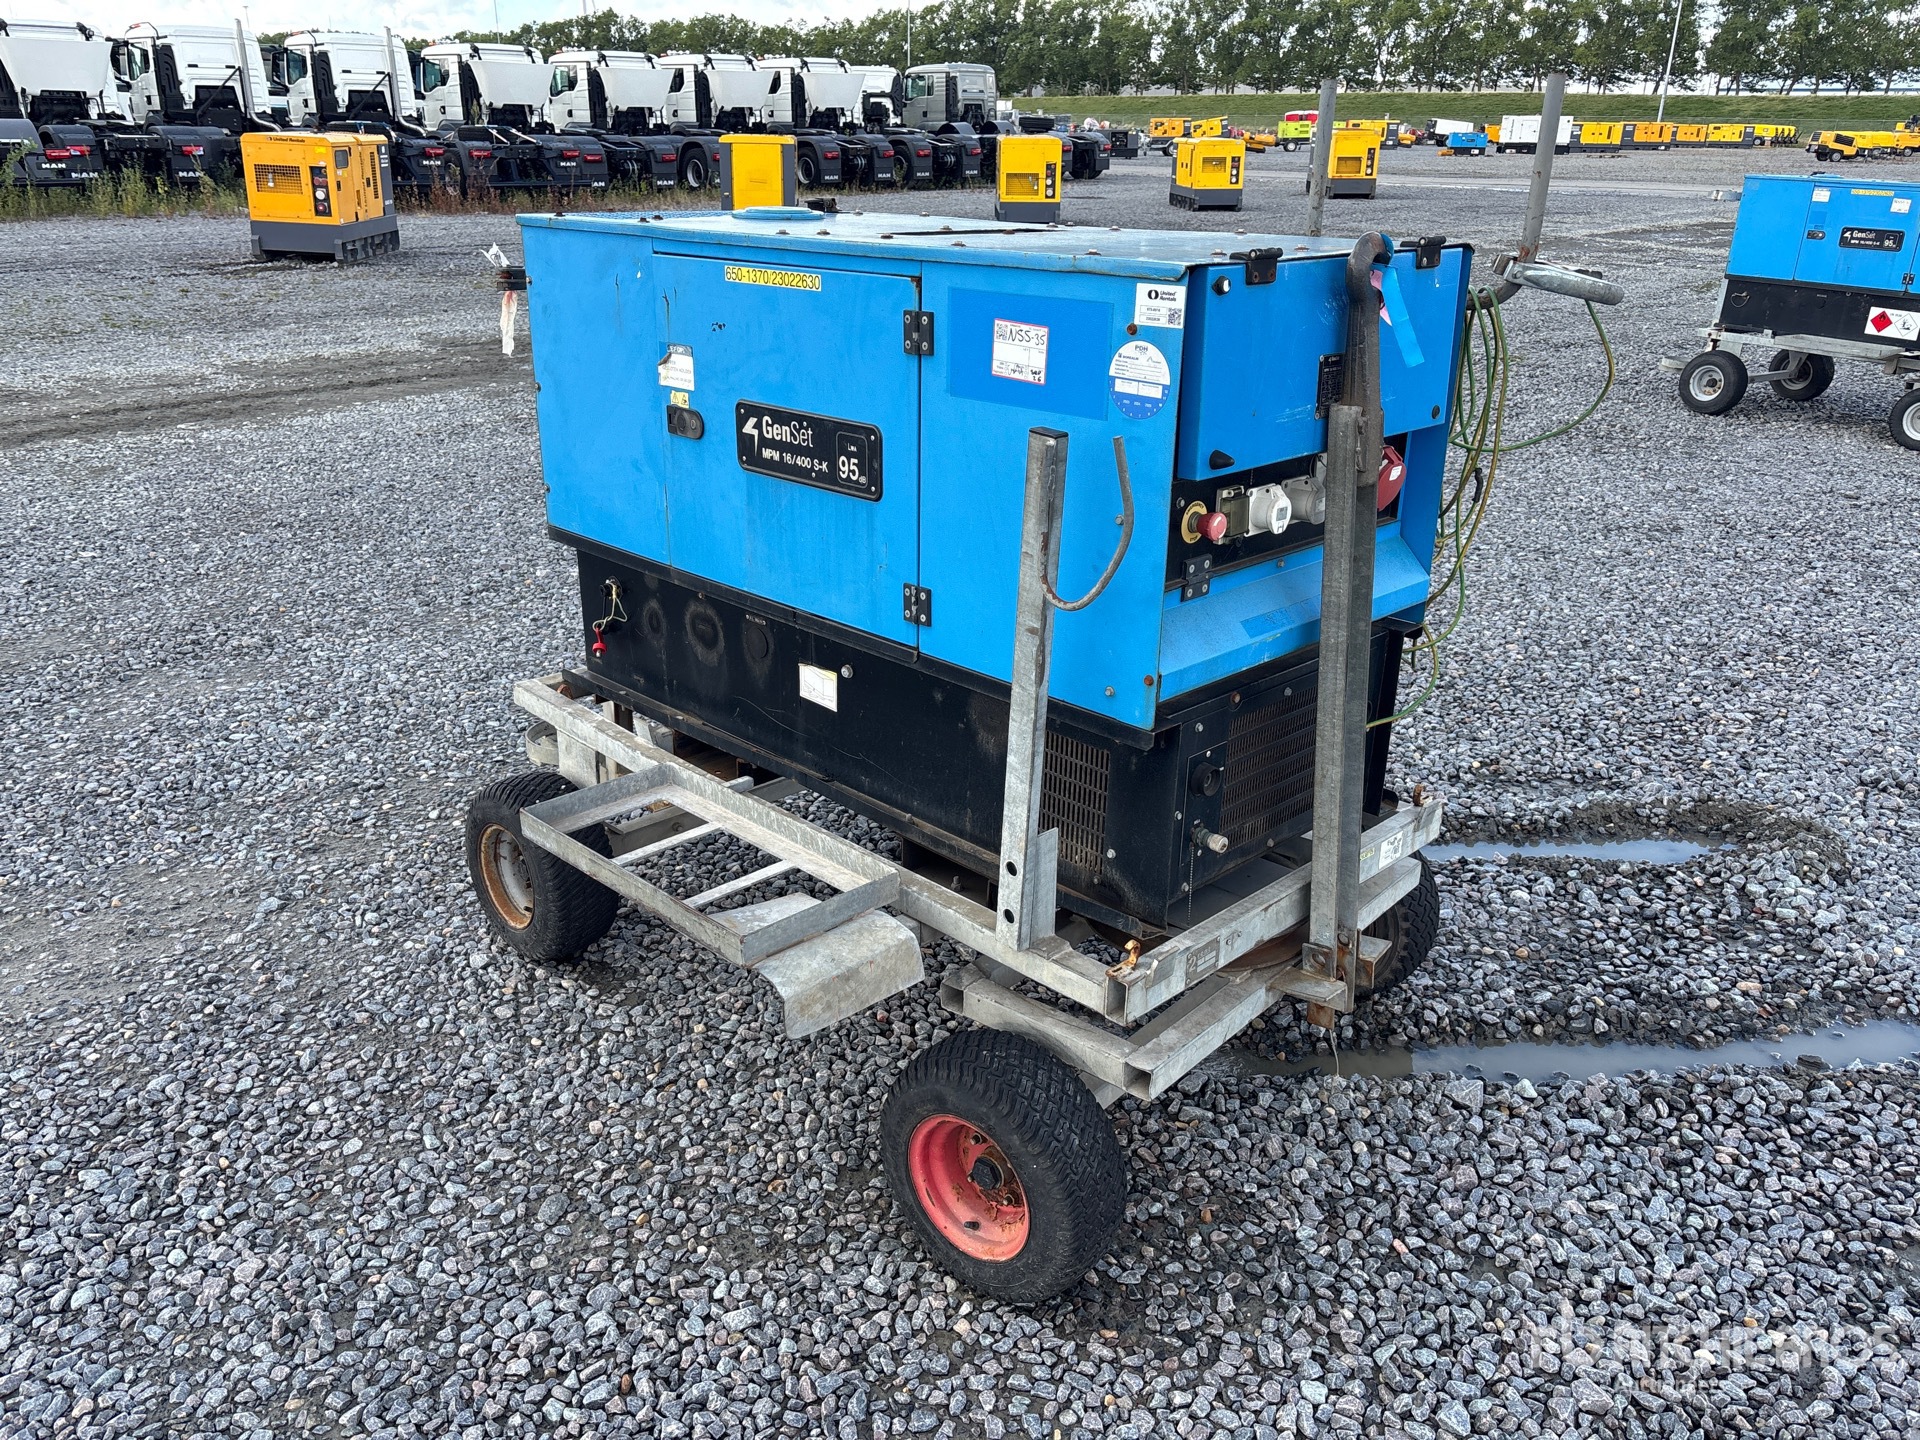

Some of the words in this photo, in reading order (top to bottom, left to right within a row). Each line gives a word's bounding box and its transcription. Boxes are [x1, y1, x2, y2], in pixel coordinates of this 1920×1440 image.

[71, 171, 99, 179] MAN
[178, 170, 204, 178] MAN
[656, 179, 675, 187] MAN
[1852, 230, 1877, 240] GenSet
[1884, 239, 1894, 247] 95
[725, 266, 821, 290] 650-1370/23022630
[762, 415, 814, 448] GenSet
[761, 447, 780, 462] MPM
[782, 452, 812, 469] 16/400
[813, 458, 829, 473] S-K
[838, 455, 859, 481] 95
